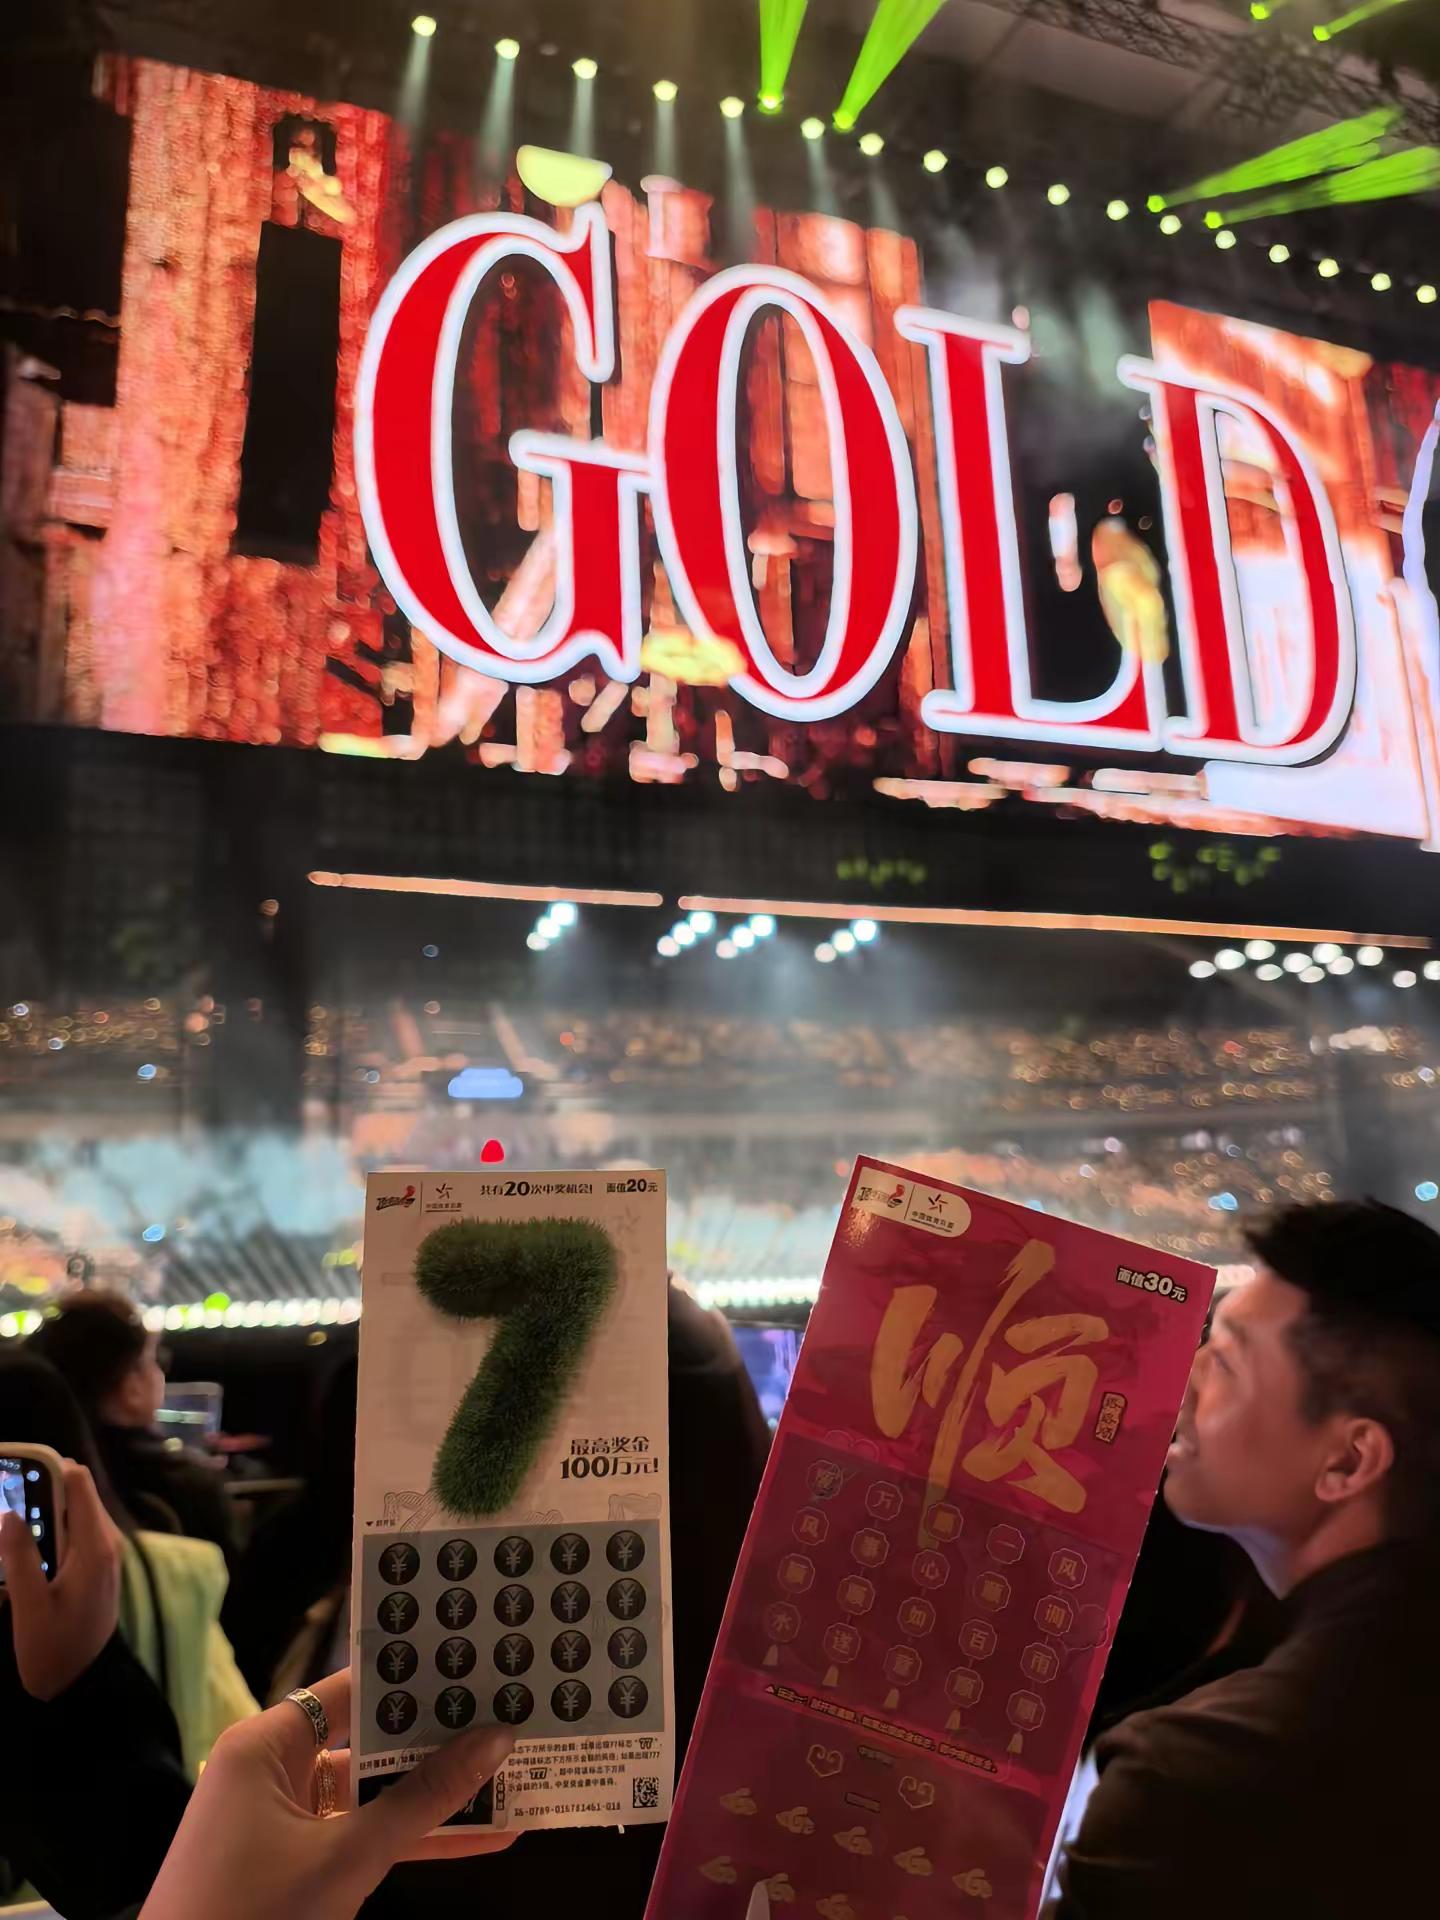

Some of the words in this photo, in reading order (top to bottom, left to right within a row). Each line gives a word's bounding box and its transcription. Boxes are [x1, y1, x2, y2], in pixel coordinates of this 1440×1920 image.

[354, 199, 1359, 767] GOLD
[606, 1178, 658, 1193] 面值20元
[1116, 1266, 1188, 1303] 面值30元
[570, 1435, 650, 1456] 最高奖金
[560, 1455, 660, 1479] 100万元!
